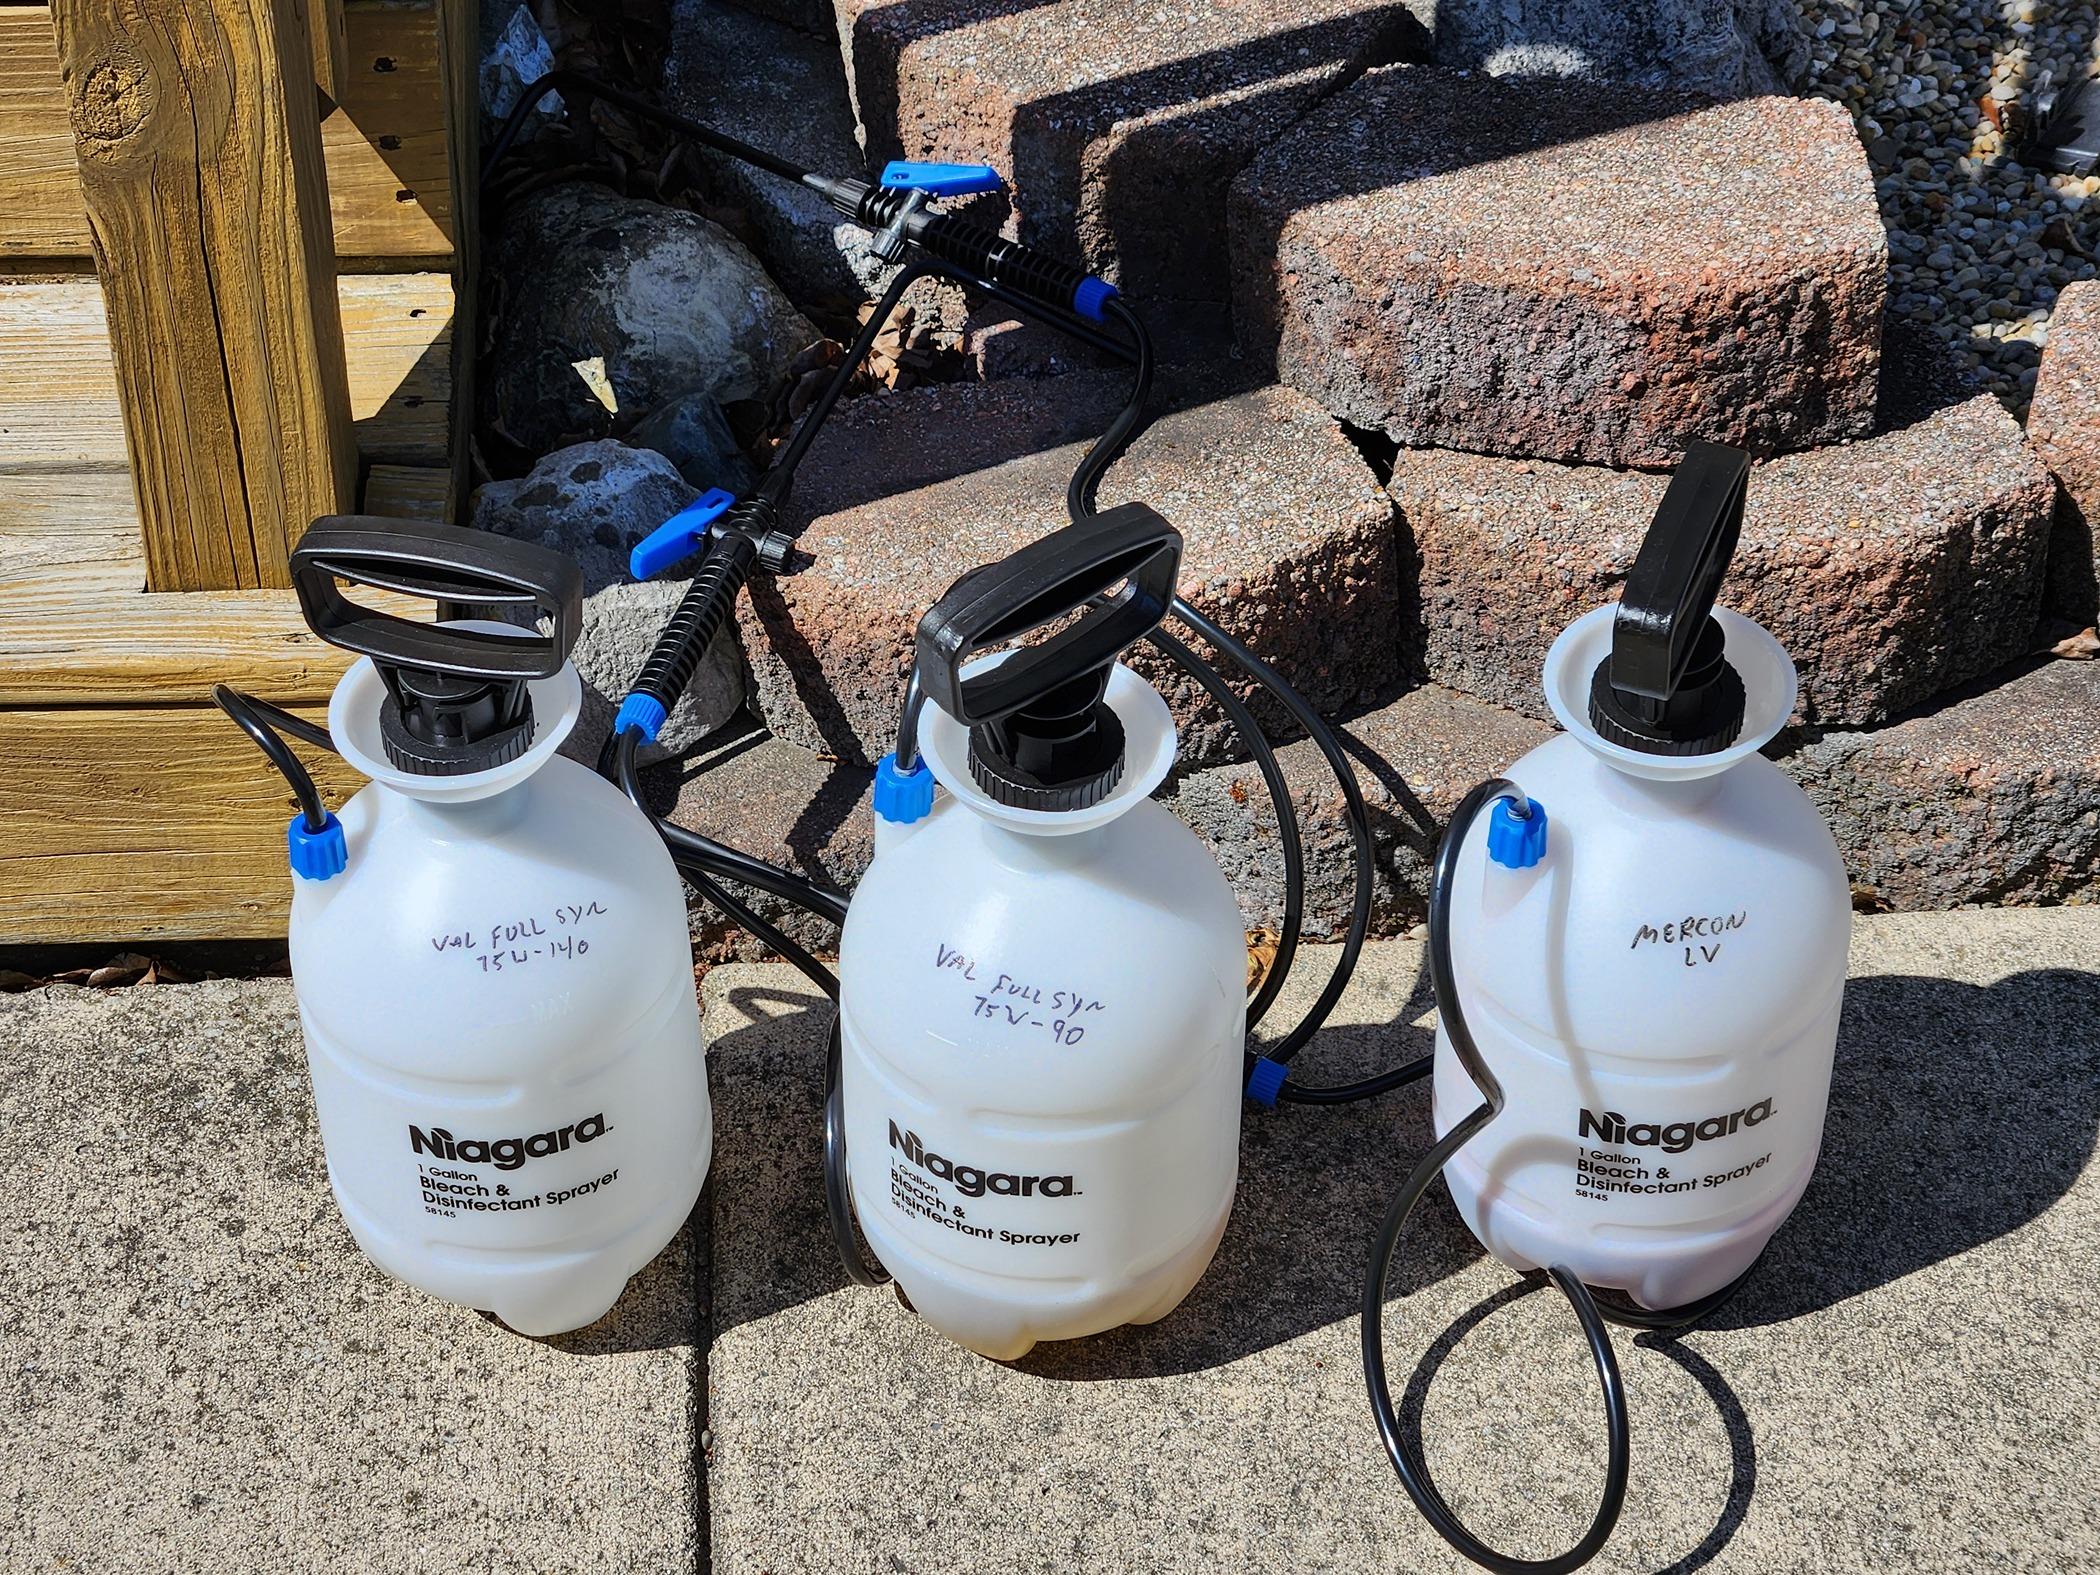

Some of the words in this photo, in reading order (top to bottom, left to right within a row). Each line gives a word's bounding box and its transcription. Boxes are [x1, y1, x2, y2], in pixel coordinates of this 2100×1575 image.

[432, 932, 476, 952] VAL
[491, 918, 546, 949] FULL
[1630, 910, 1747, 950] MERCON
[936, 943, 976, 981] VAL
[991, 974, 1041, 1004] FULL
[1684, 943, 1721, 967] LV
[408, 1112, 606, 1171] Niagara
[1578, 1097, 1772, 1154] Niagara
[417, 1163, 424, 1173] 1
[429, 1166, 478, 1182] Gallon
[888, 1117, 1075, 1198] Niagara
[1576, 1173, 1699, 1195] Disinfectant
[1702, 1152, 1773, 1188] Sprayer
[1577, 1158, 1649, 1180] Bleach
[1656, 1167, 1670, 1180] &
[1578, 1146, 1585, 1156] 1
[1590, 1149, 1641, 1165] Gallon
[419, 1175, 490, 1197] Bleach
[496, 1183, 511, 1197] &
[422, 1190, 541, 1212] Disinfectant
[545, 1168, 620, 1205] Sprayer
[891, 1167, 947, 1212] Bleach
[952, 1205, 966, 1219] &
[899, 1164, 939, 1194] Gallon
[1575, 1188, 1609, 1202] 58145
[425, 1206, 457, 1219] 58145
[891, 1181, 994, 1240] Disinfectant
[999, 1230, 1081, 1246] Sprayer
